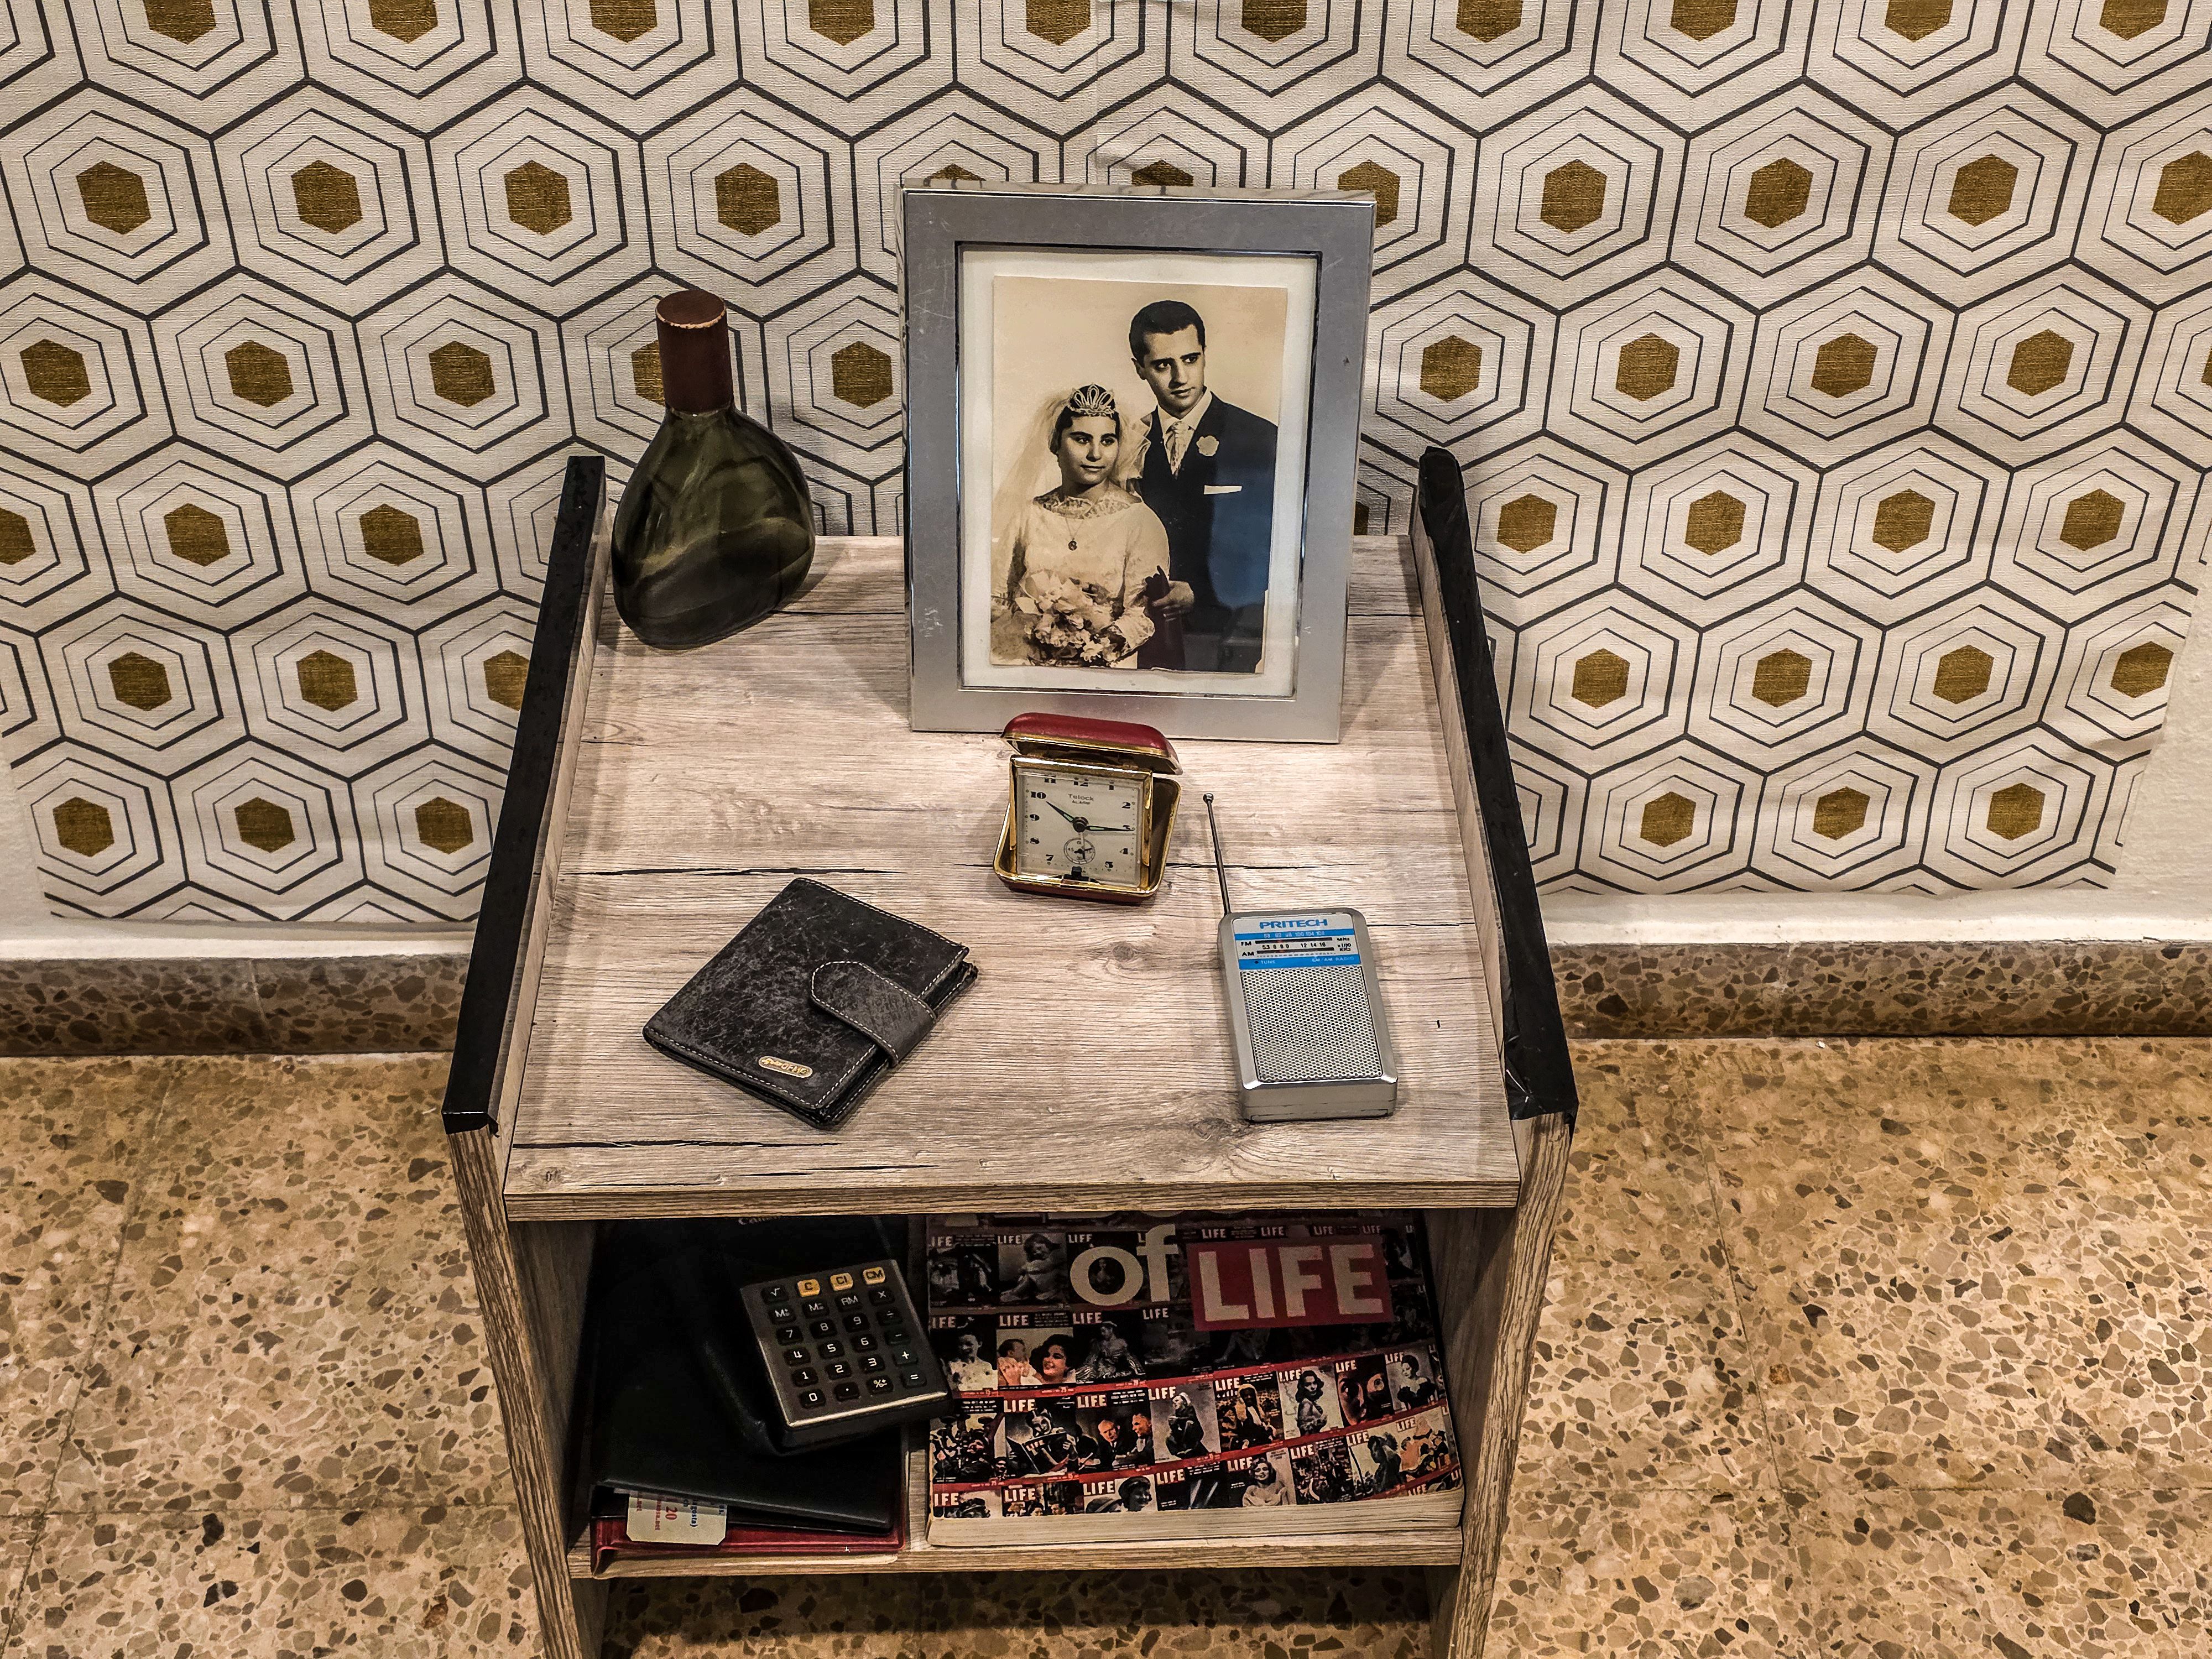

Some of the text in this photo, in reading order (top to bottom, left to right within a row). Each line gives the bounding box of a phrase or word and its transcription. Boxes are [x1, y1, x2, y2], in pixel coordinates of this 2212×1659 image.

[1031, 791, 1046, 799] 10
[1259, 919, 1327, 930] PRITECH
[1202, 1229, 1226, 1239] LIFE
[1261, 1226, 1285, 1237] LIFE
[1313, 1225, 1333, 1235] LIFE
[931, 1236, 953, 1247] IFE
[997, 1235, 1022, 1244] LIFE
[1070, 1224, 1384, 1321] of LIFE
[805, 1282, 813, 1291] C
[866, 1270, 883, 1279] CM
[841, 1296, 858, 1306] RM
[1072, 1312, 1102, 1324] LIFE
[1142, 1308, 1169, 1319] LIFE
[786, 1329, 793, 1338] 7
[820, 1322, 828, 1331] 8
[853, 1316, 862, 1326] 9
[932, 1316, 956, 1328] IFE
[999, 1314, 1029, 1327] LIFE
[794, 1350, 802, 1359] 4
[827, 1343, 836, 1353] 5
[860, 1337, 869, 1346] 6
[802, 1371, 808, 1380] 1
[834, 1364, 844, 1373] 2
[868, 1358, 877, 1366] 3
[1335, 1360, 1357, 1373] LIFE
[1279, 1369, 1301, 1382] LIFE
[1215, 1378, 1240, 1391] LIFE
[808, 1392, 817, 1402] 0
[1077, 1395, 1107, 1408] LIFE
[1003, 1399, 1035, 1412] LIFE
[1396, 1418, 1416, 1431] LIFE
[1346, 1431, 1369, 1446] LIFE
[1290, 1444, 1314, 1459] LIFE
[1156, 1469, 1185, 1484] LIFE
[1004, 1488, 1036, 1502] LIFE
[1083, 1481, 1114, 1496] LIFE
[935, 1493, 959, 1506] IFE
[665, 1506, 678, 1520] 20
